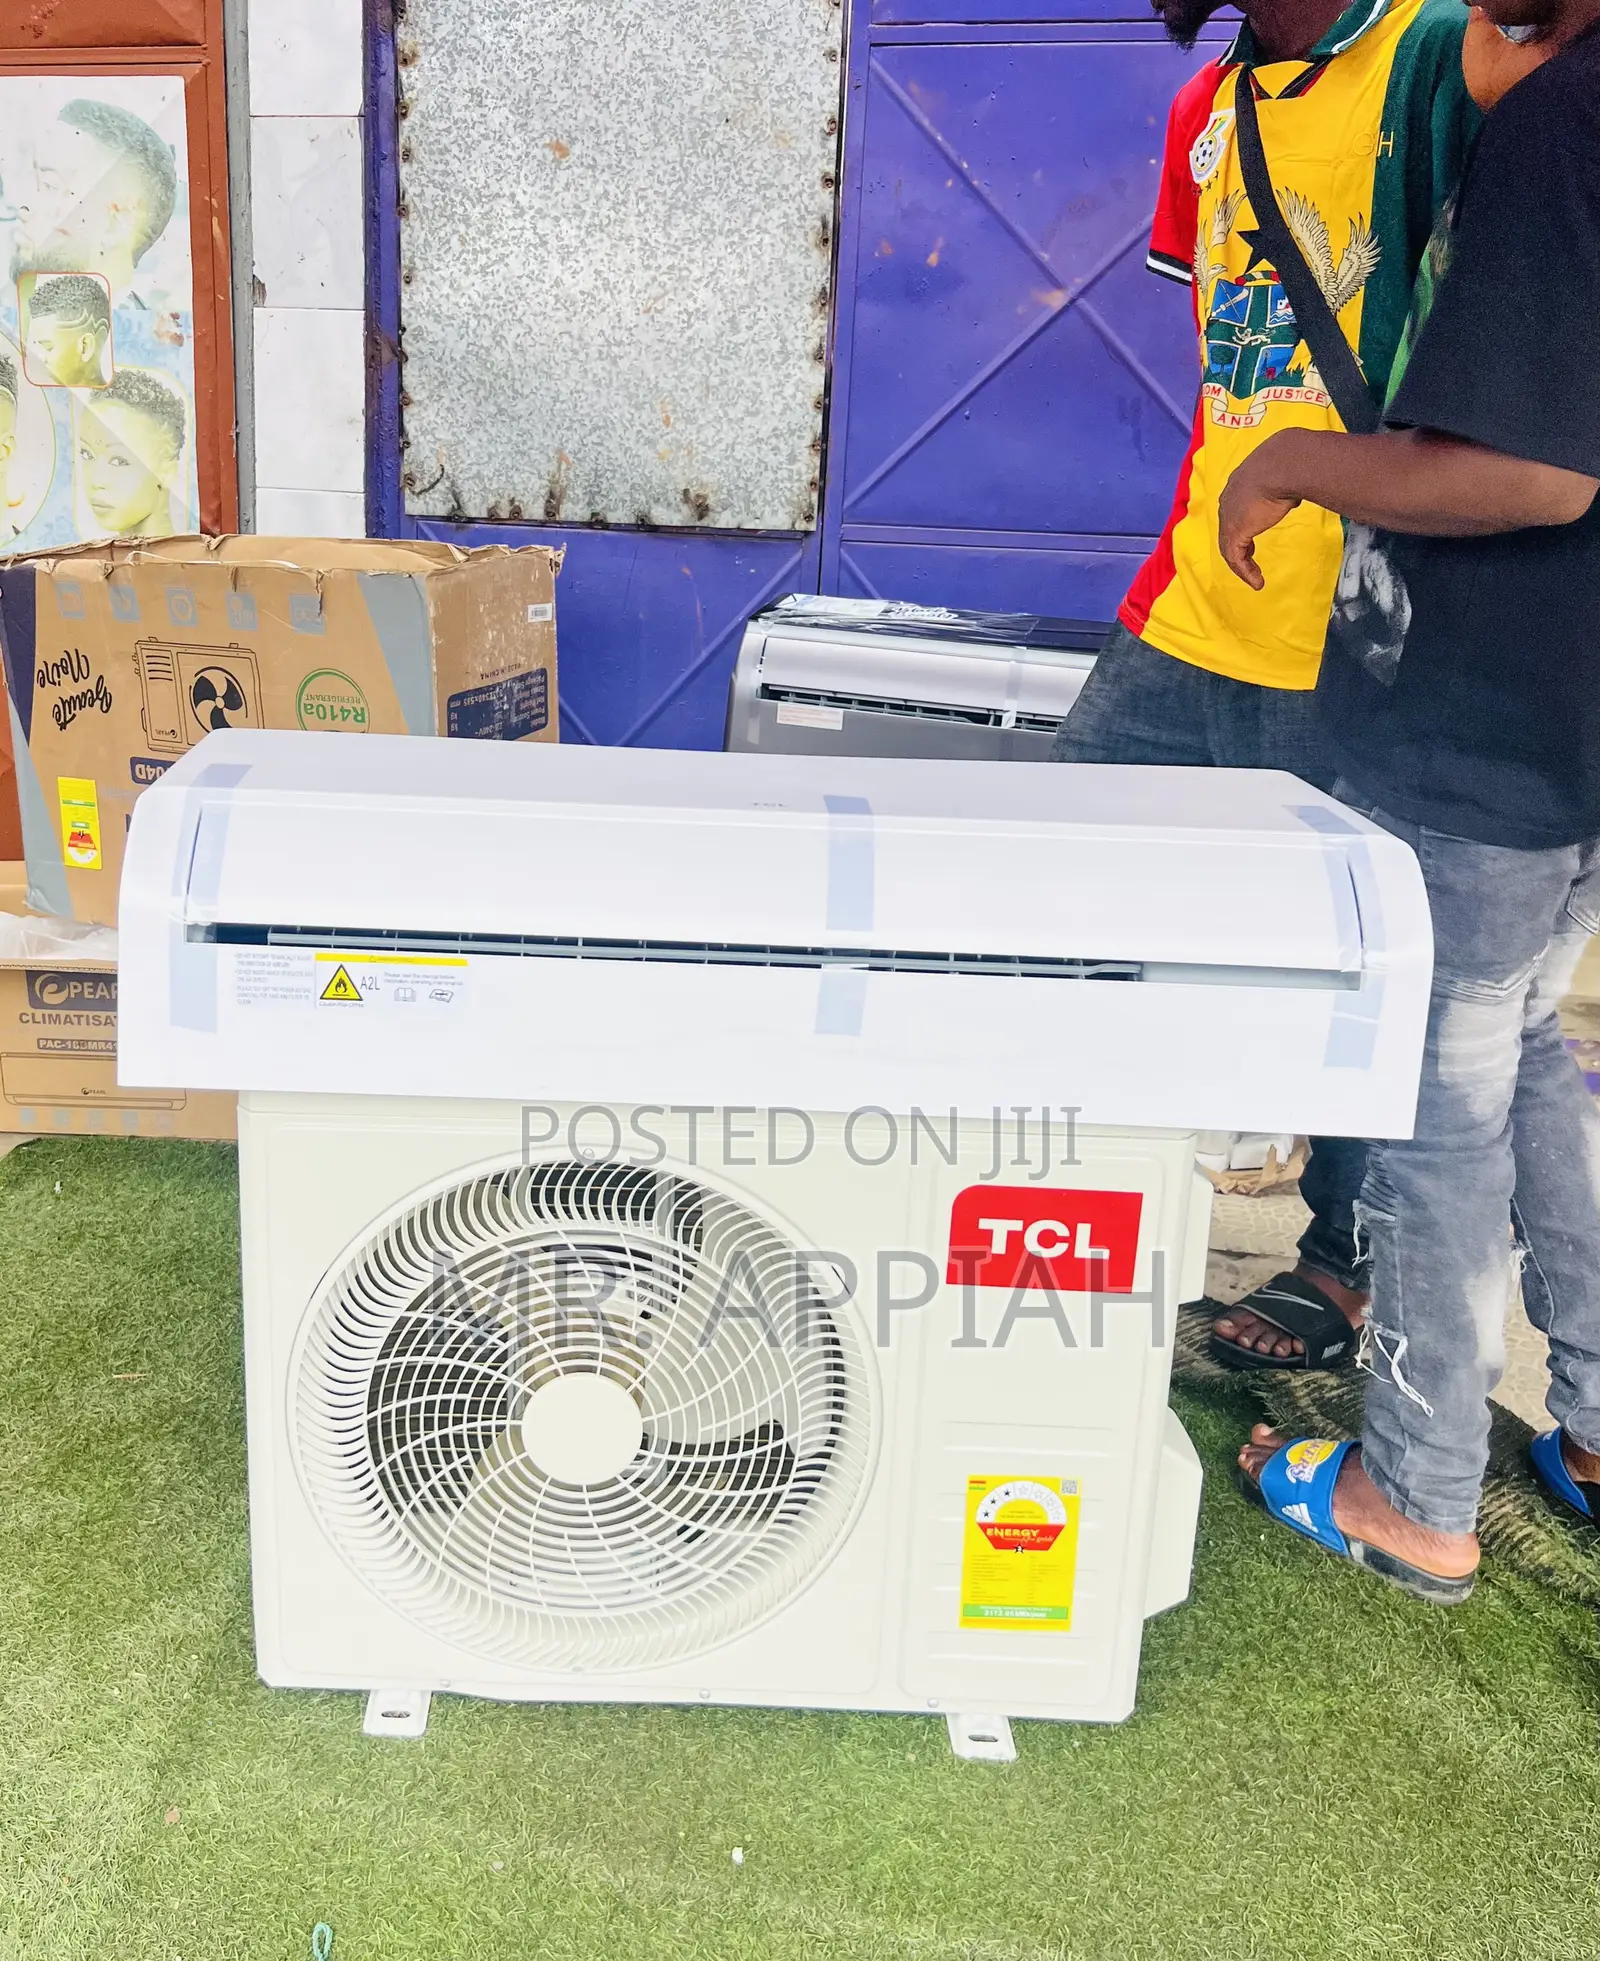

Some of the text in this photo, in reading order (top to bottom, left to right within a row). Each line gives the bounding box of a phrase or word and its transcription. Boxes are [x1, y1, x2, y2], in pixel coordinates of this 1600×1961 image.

[1262, 388, 1327, 404] JUSTICE
[1217, 413, 1254, 426] AND
[36, 649, 90, 689] Noire
[480, 669, 500, 680] CHINA
[305, 693, 361, 704] REFRIGERANT
[303, 703, 366, 723] R410a
[360, 976, 380, 990] A2L
[19, 1012, 117, 1028] CLIMATISA
[978, 1218, 1110, 1260] TCL
[986, 1527, 1040, 1539] ENERGY
